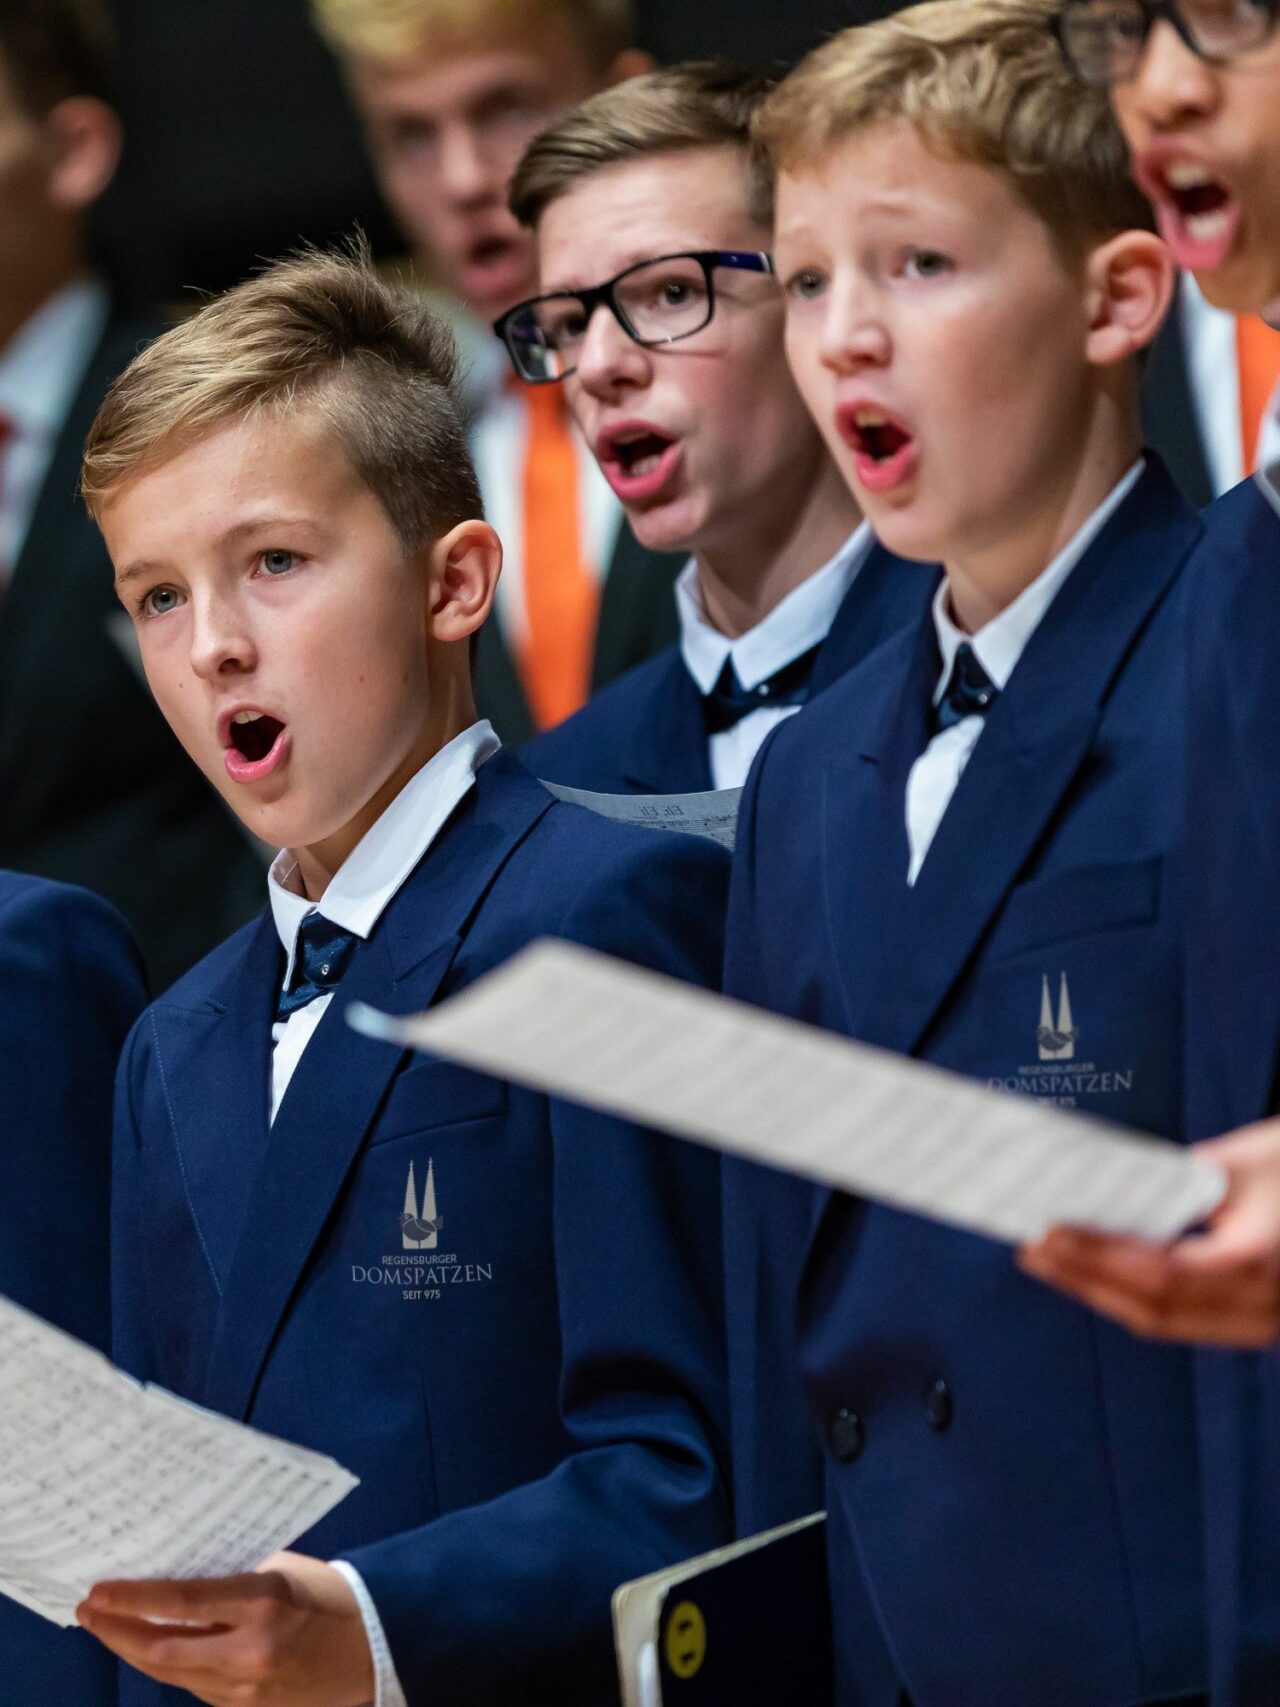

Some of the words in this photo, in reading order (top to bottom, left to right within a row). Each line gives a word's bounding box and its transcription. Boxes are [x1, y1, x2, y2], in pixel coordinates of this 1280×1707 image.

[987, 1069, 1134, 1094] DOMSPATZEN
[381, 1253, 458, 1266] REGENSBURGER
[351, 1263, 493, 1285] DOMSPATZEN
[402, 1290, 422, 1300] SEIT
[424, 1289, 441, 1300] 975
